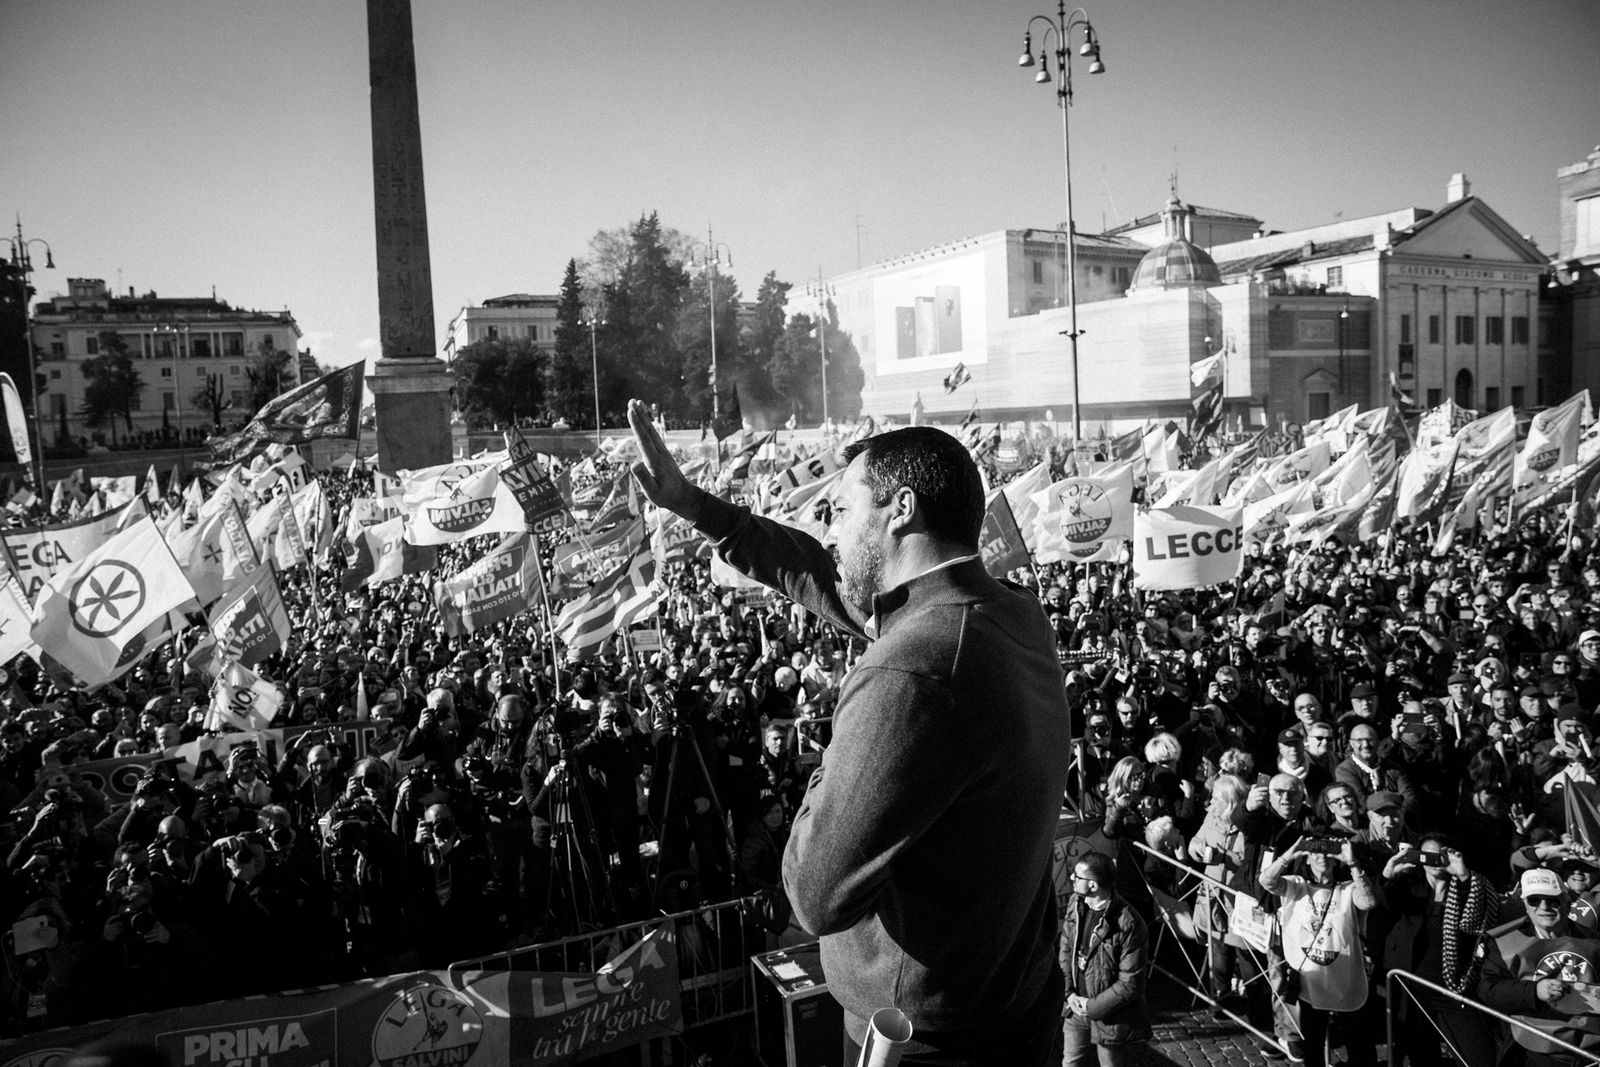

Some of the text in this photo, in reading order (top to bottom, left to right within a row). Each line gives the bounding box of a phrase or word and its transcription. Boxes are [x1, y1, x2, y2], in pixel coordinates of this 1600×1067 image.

[1145, 524, 1242, 561] LECCE
[531, 941, 666, 1018] LEGA
[385, 989, 468, 1028] LEGA
[533, 1033, 574, 1060] tra
[602, 999, 672, 1043] gente
[184, 1022, 310, 1066] PRIMA
